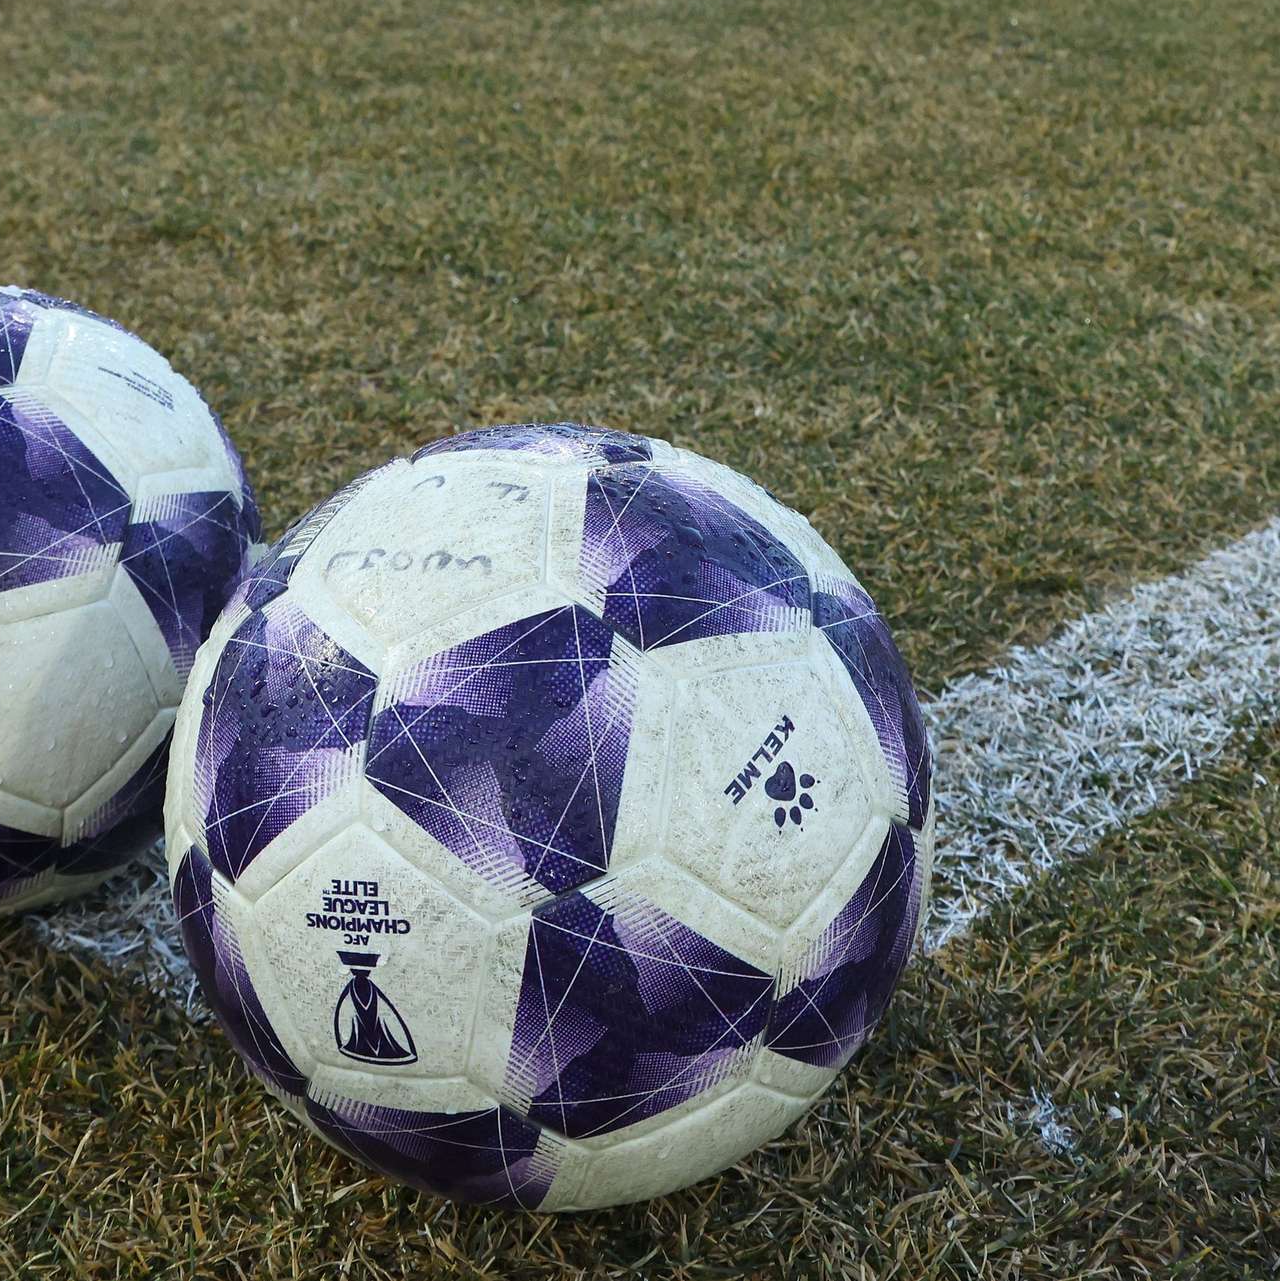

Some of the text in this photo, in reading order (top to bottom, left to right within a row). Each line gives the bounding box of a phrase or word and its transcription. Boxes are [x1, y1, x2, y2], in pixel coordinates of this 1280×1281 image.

[723, 714, 795, 806] KELME
[322, 897, 390, 916] LEAGUE
[306, 913, 411, 935] CHAMPIONS
[343, 933, 370, 946] AFC
